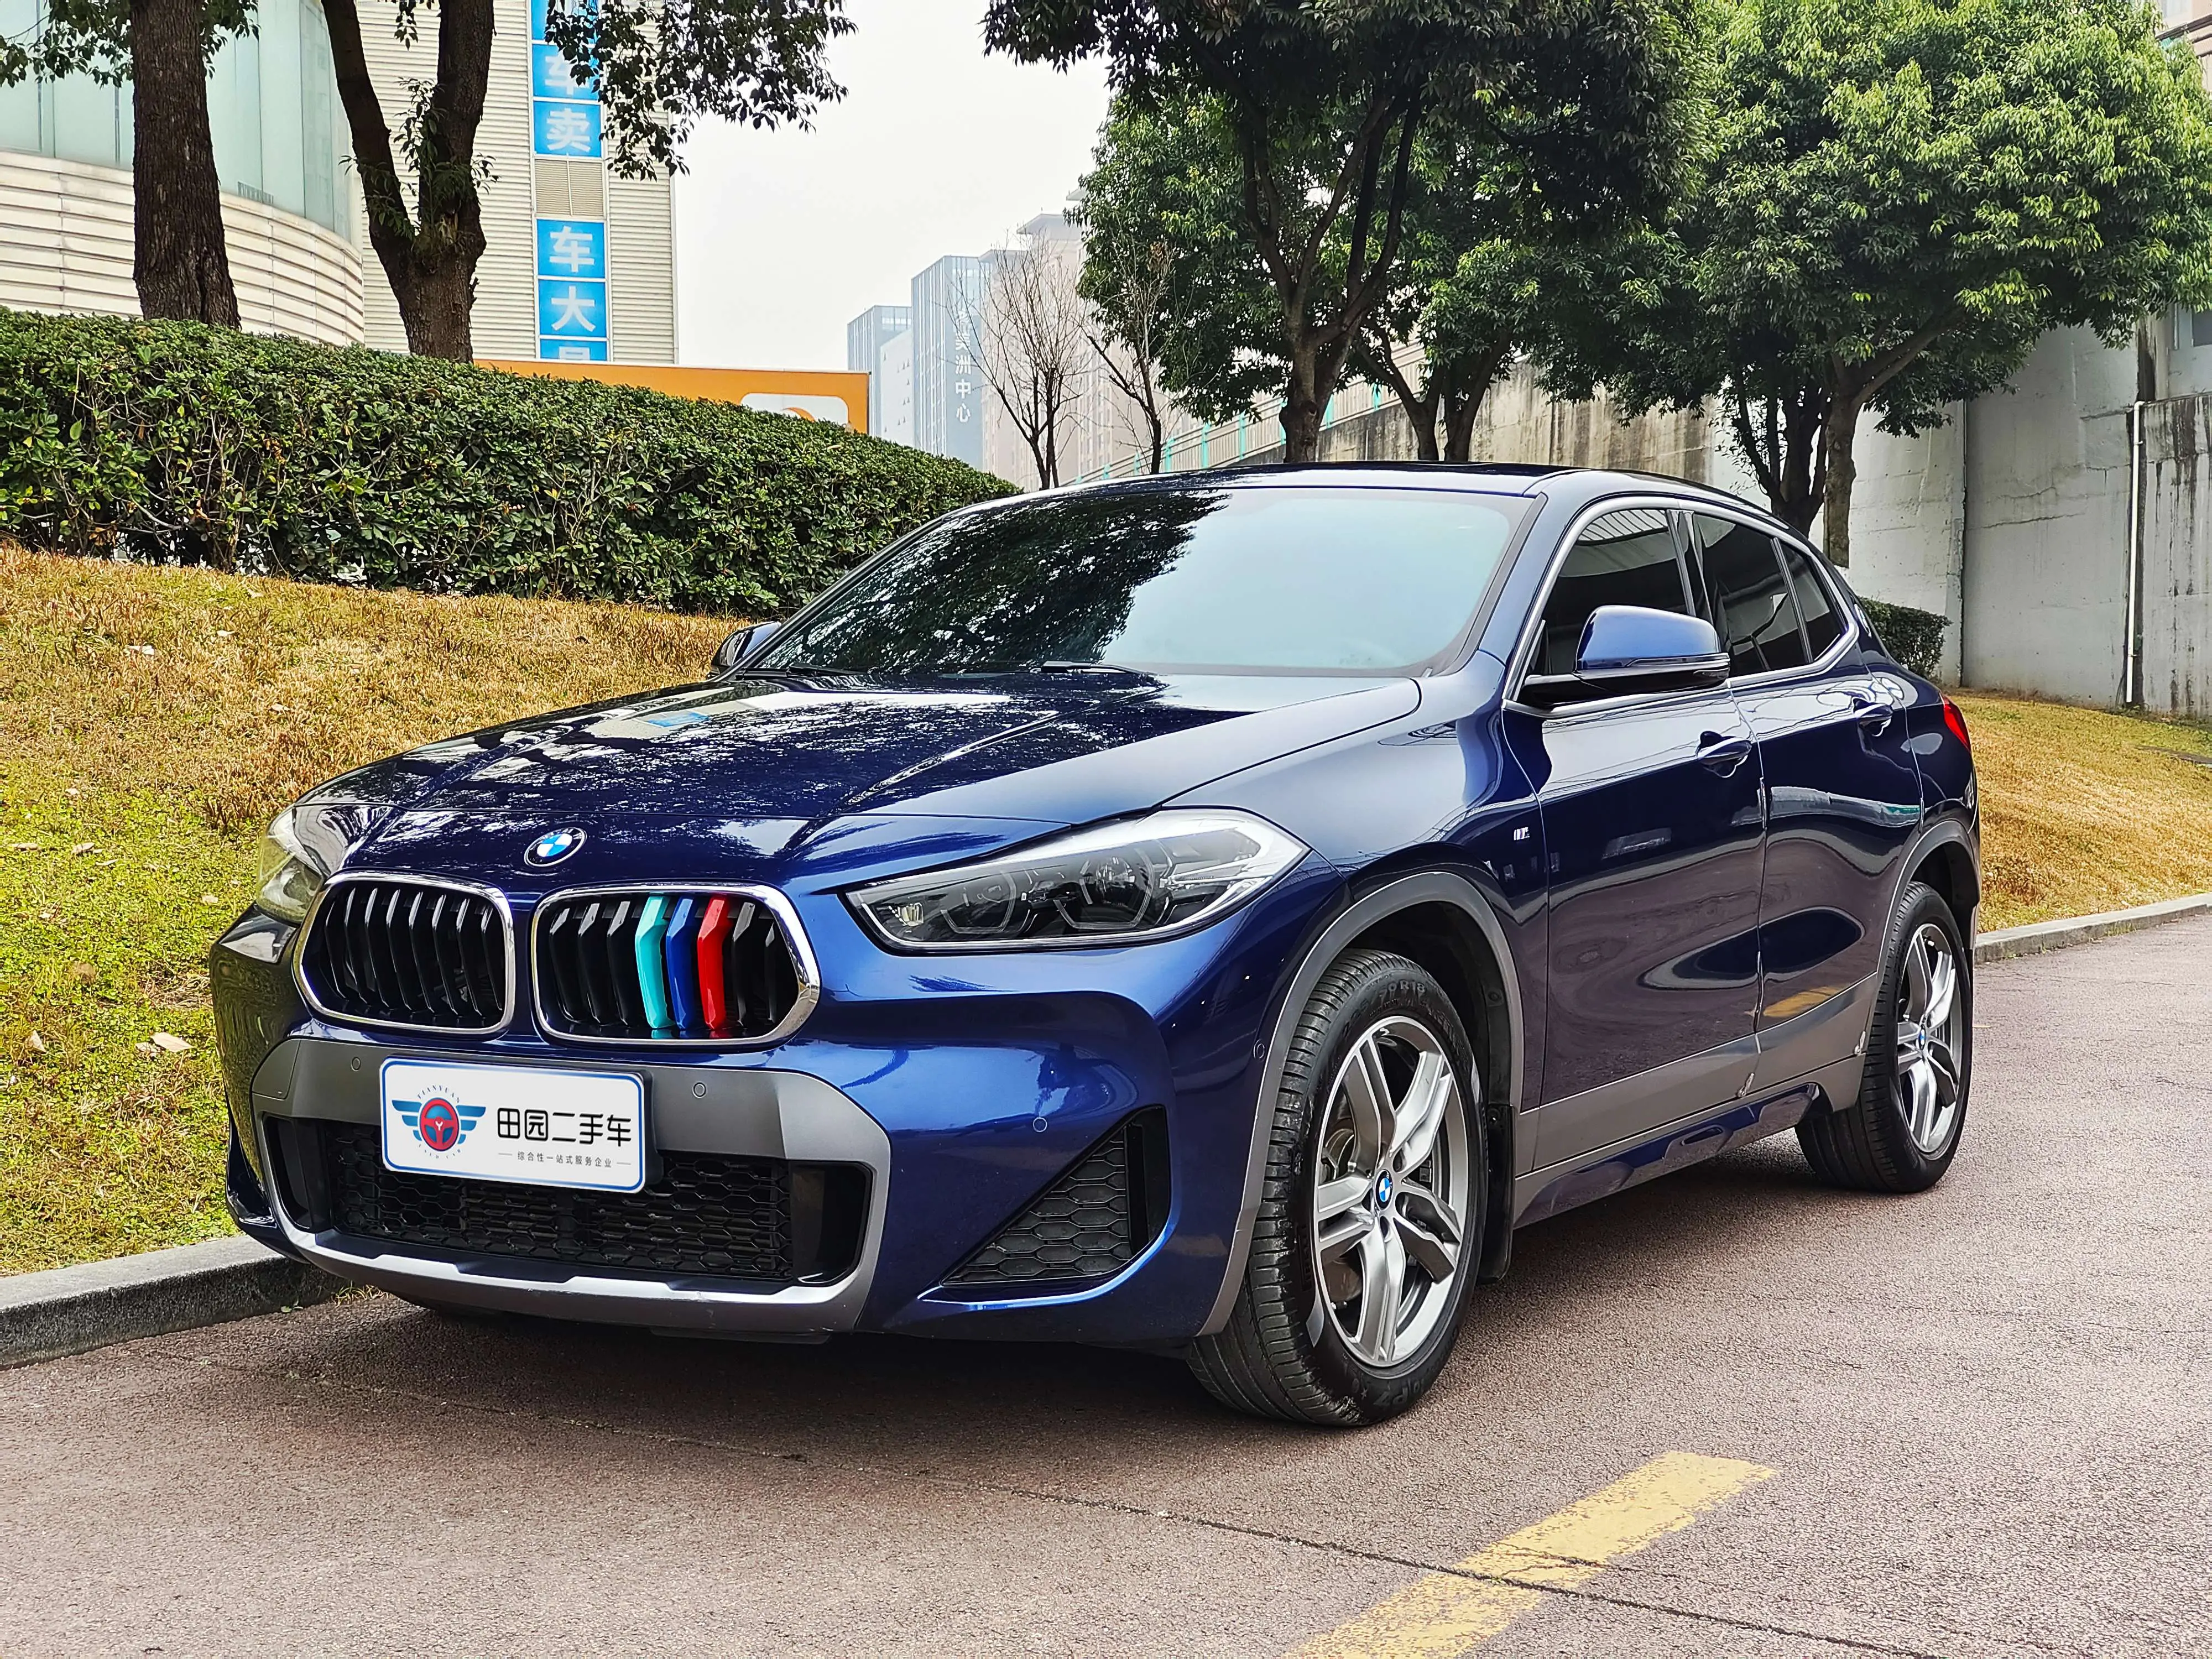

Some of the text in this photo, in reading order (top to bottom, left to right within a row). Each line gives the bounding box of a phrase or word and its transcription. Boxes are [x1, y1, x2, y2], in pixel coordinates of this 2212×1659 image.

[954, 310, 972, 423] 美洲中心
[498, 1108, 632, 1147] 田园二手车
[518, 1151, 612, 1168] 综合性一站式服务企业
